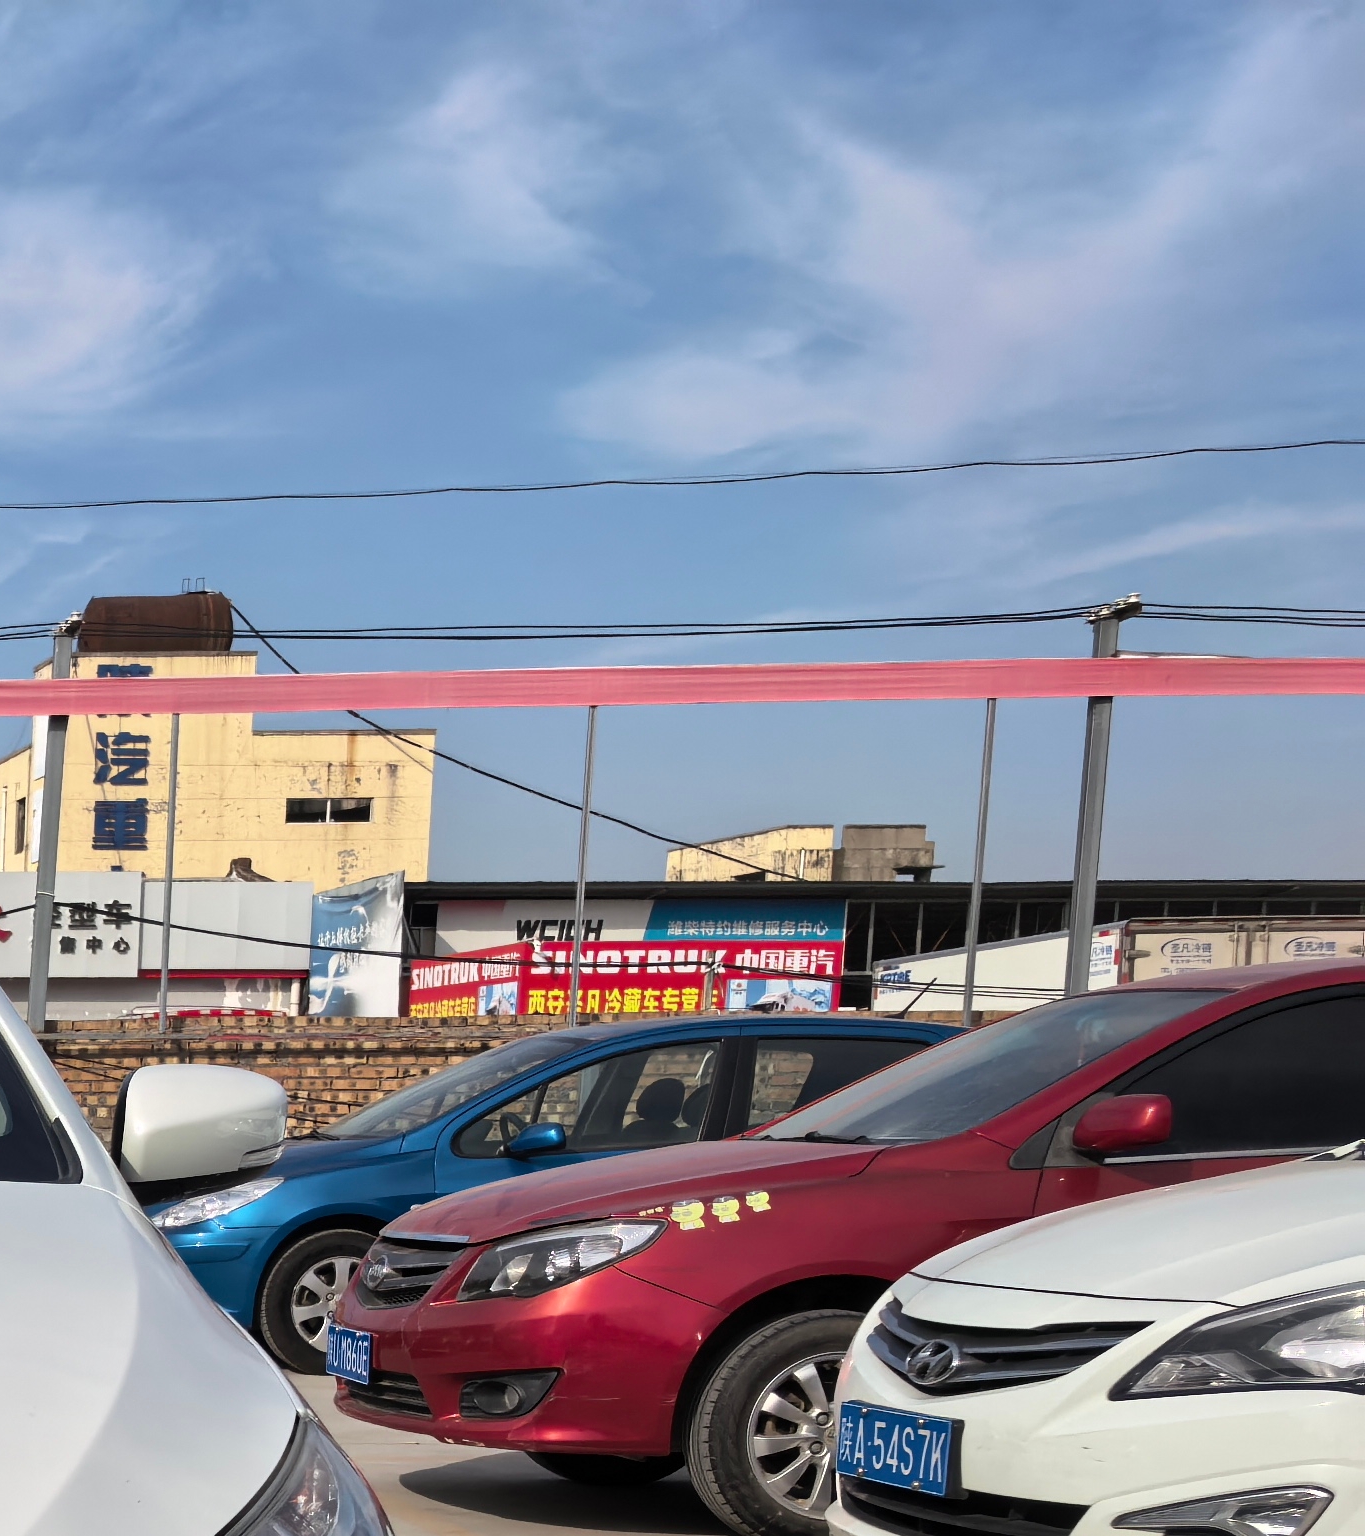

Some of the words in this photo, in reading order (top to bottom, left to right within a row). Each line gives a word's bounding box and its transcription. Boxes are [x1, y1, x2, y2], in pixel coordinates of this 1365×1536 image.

[92, 664, 153, 871] 汽重
[667, 919, 829, 936] 潍柴特约维修服务中心
[530, 949, 728, 975] SINOTRUK
[735, 948, 835, 975] 中国重汽
[410, 961, 479, 991] SINOTRUK
